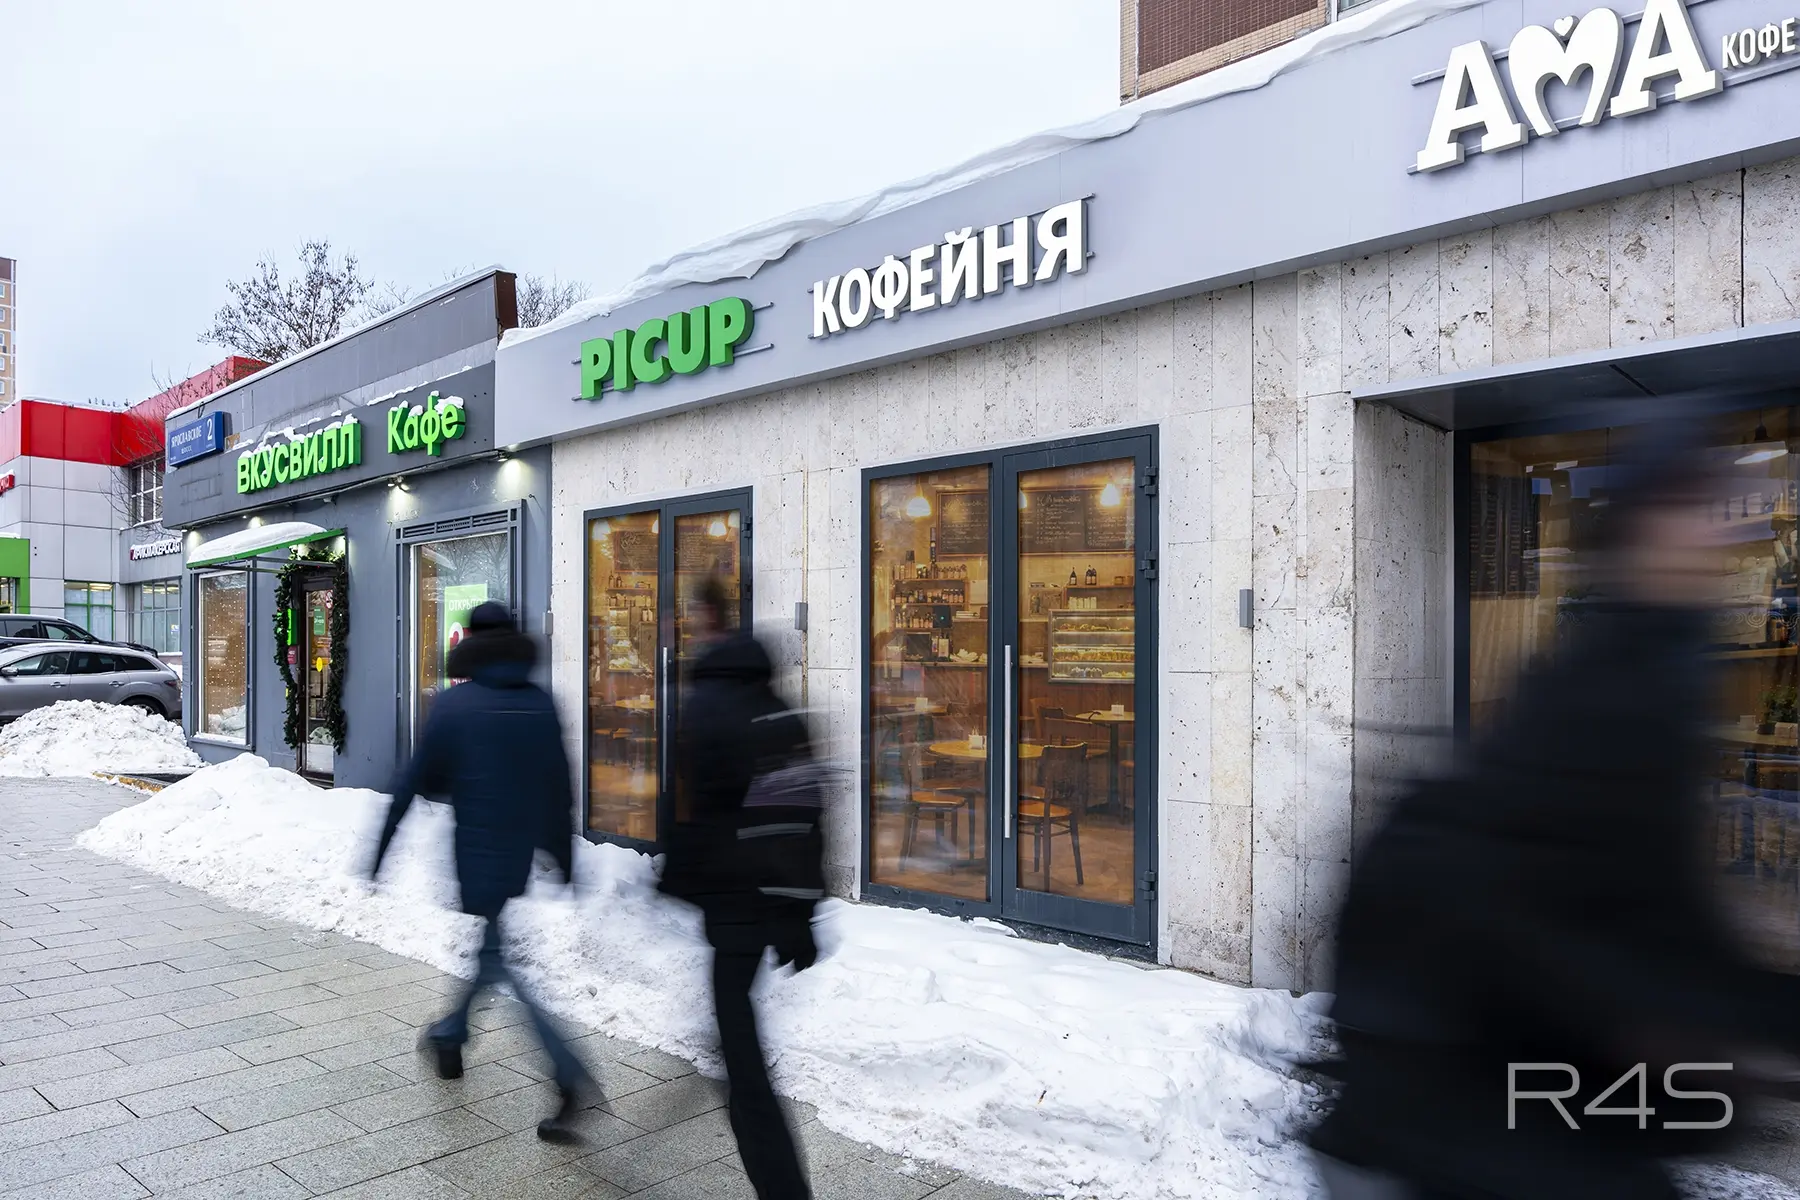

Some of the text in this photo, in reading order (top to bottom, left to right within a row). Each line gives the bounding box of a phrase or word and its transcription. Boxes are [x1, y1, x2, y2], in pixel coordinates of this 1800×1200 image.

[1722, 17, 1800, 69] КОФЕ
[812, 199, 1088, 338] КОФЕЙНЯ
[580, 296, 755, 401] PICUP
[171, 425, 202, 448] ЯРОСЛАВСКОЕ
[207, 418, 213, 441] 2
[237, 394, 466, 494] ВКУСВИЛЛ Кафе
